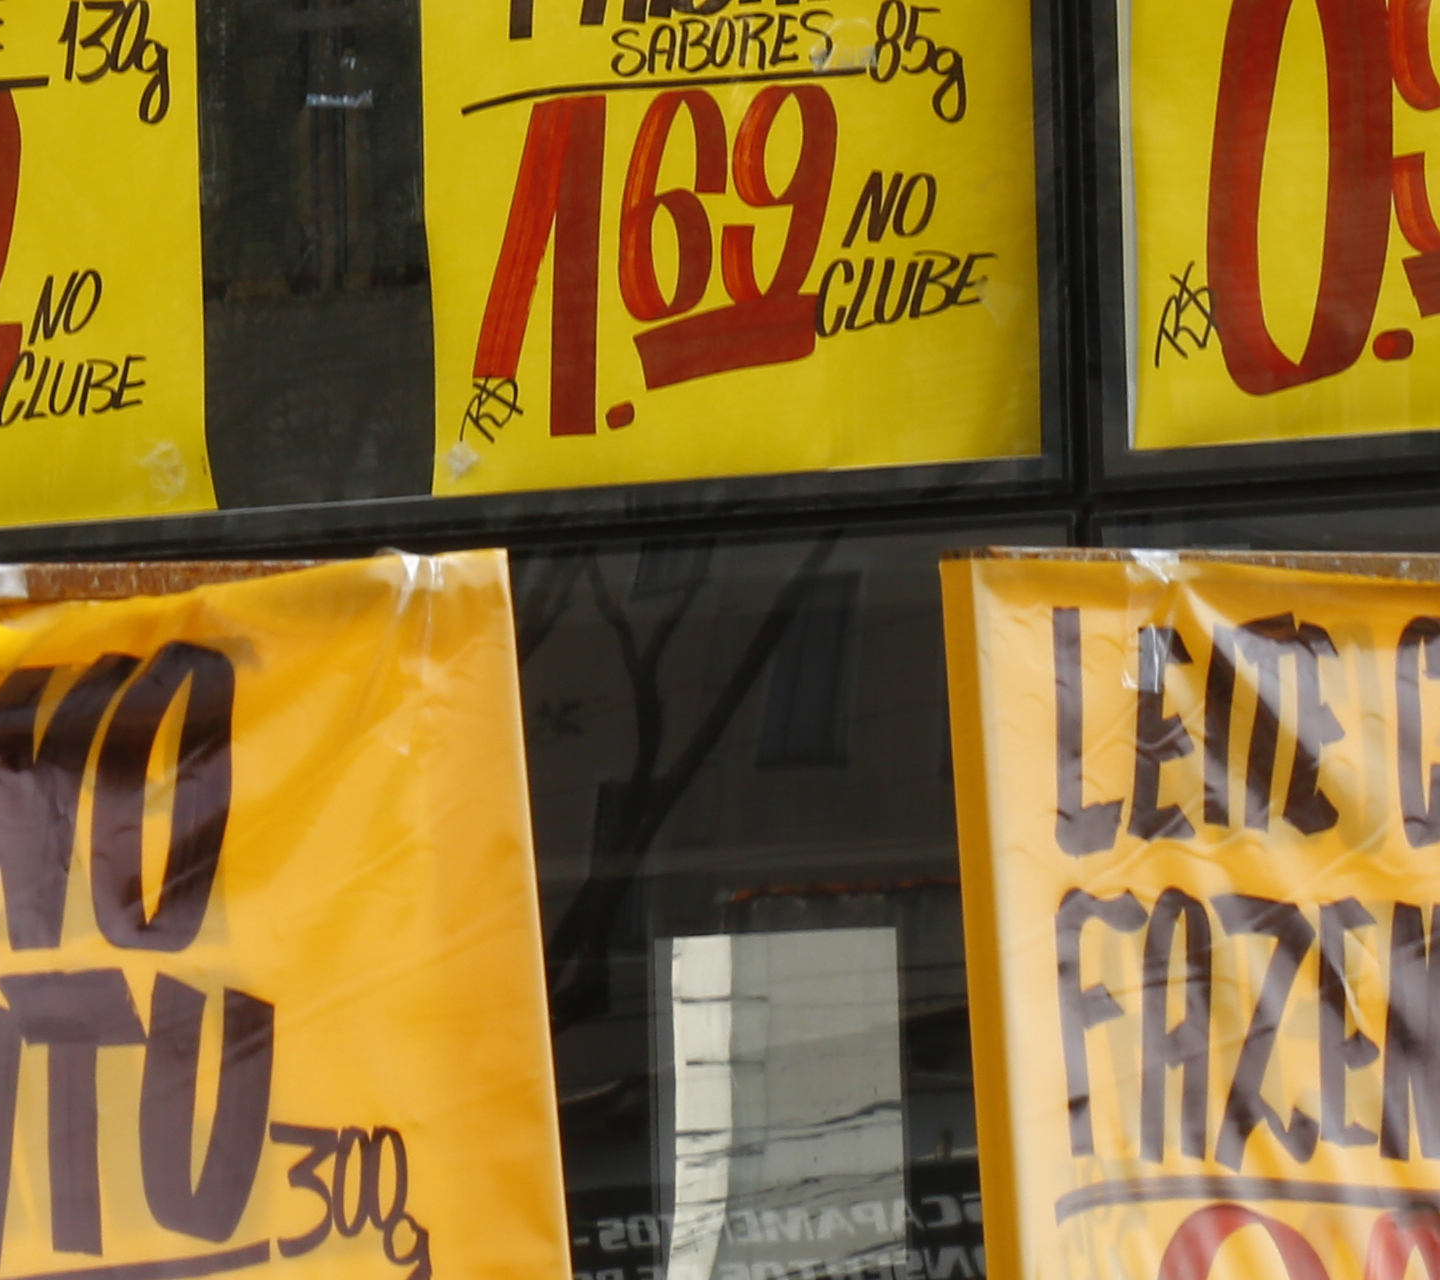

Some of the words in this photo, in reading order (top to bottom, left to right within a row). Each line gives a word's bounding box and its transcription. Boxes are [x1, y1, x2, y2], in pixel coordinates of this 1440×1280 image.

[59, 0, 169, 123] 130g
[611, 11, 832, 78] SABORES
[842, 171, 936, 248] NO
[29, 270, 100, 346] NO
[816, 252, 1000, 340] CLUBE
[1052, 606, 1339, 857] LEITE
